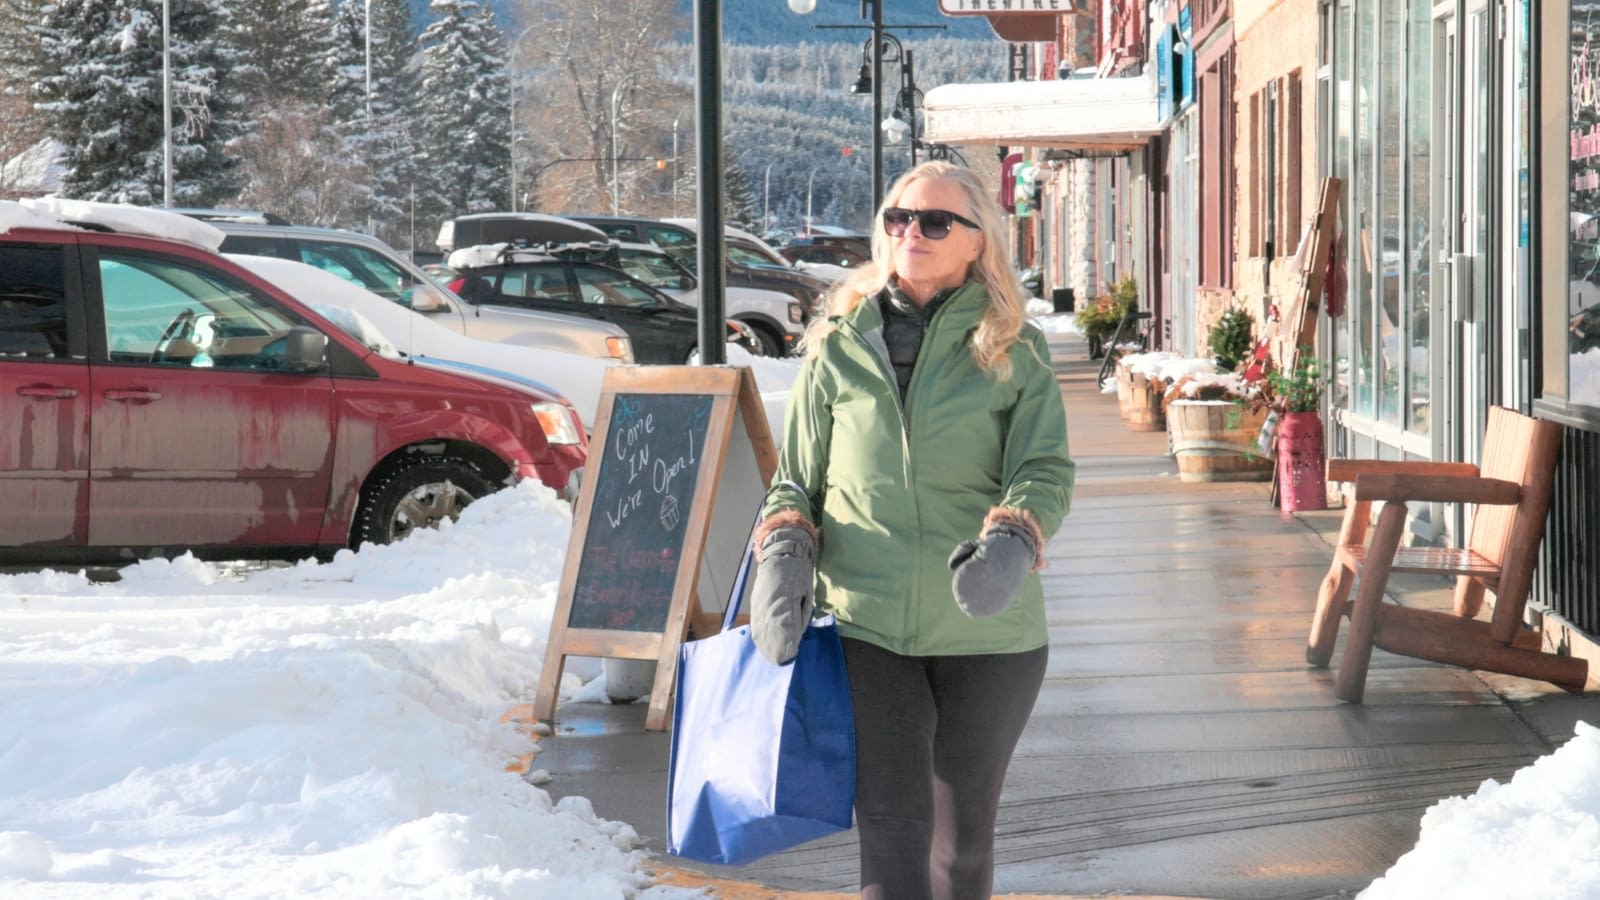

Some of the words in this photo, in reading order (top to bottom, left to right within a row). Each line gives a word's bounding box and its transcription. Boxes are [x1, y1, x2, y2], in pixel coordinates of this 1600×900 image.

[616, 413, 655, 461] Come
[606, 489, 642, 528] We're
[653, 429, 695, 494] Open!
